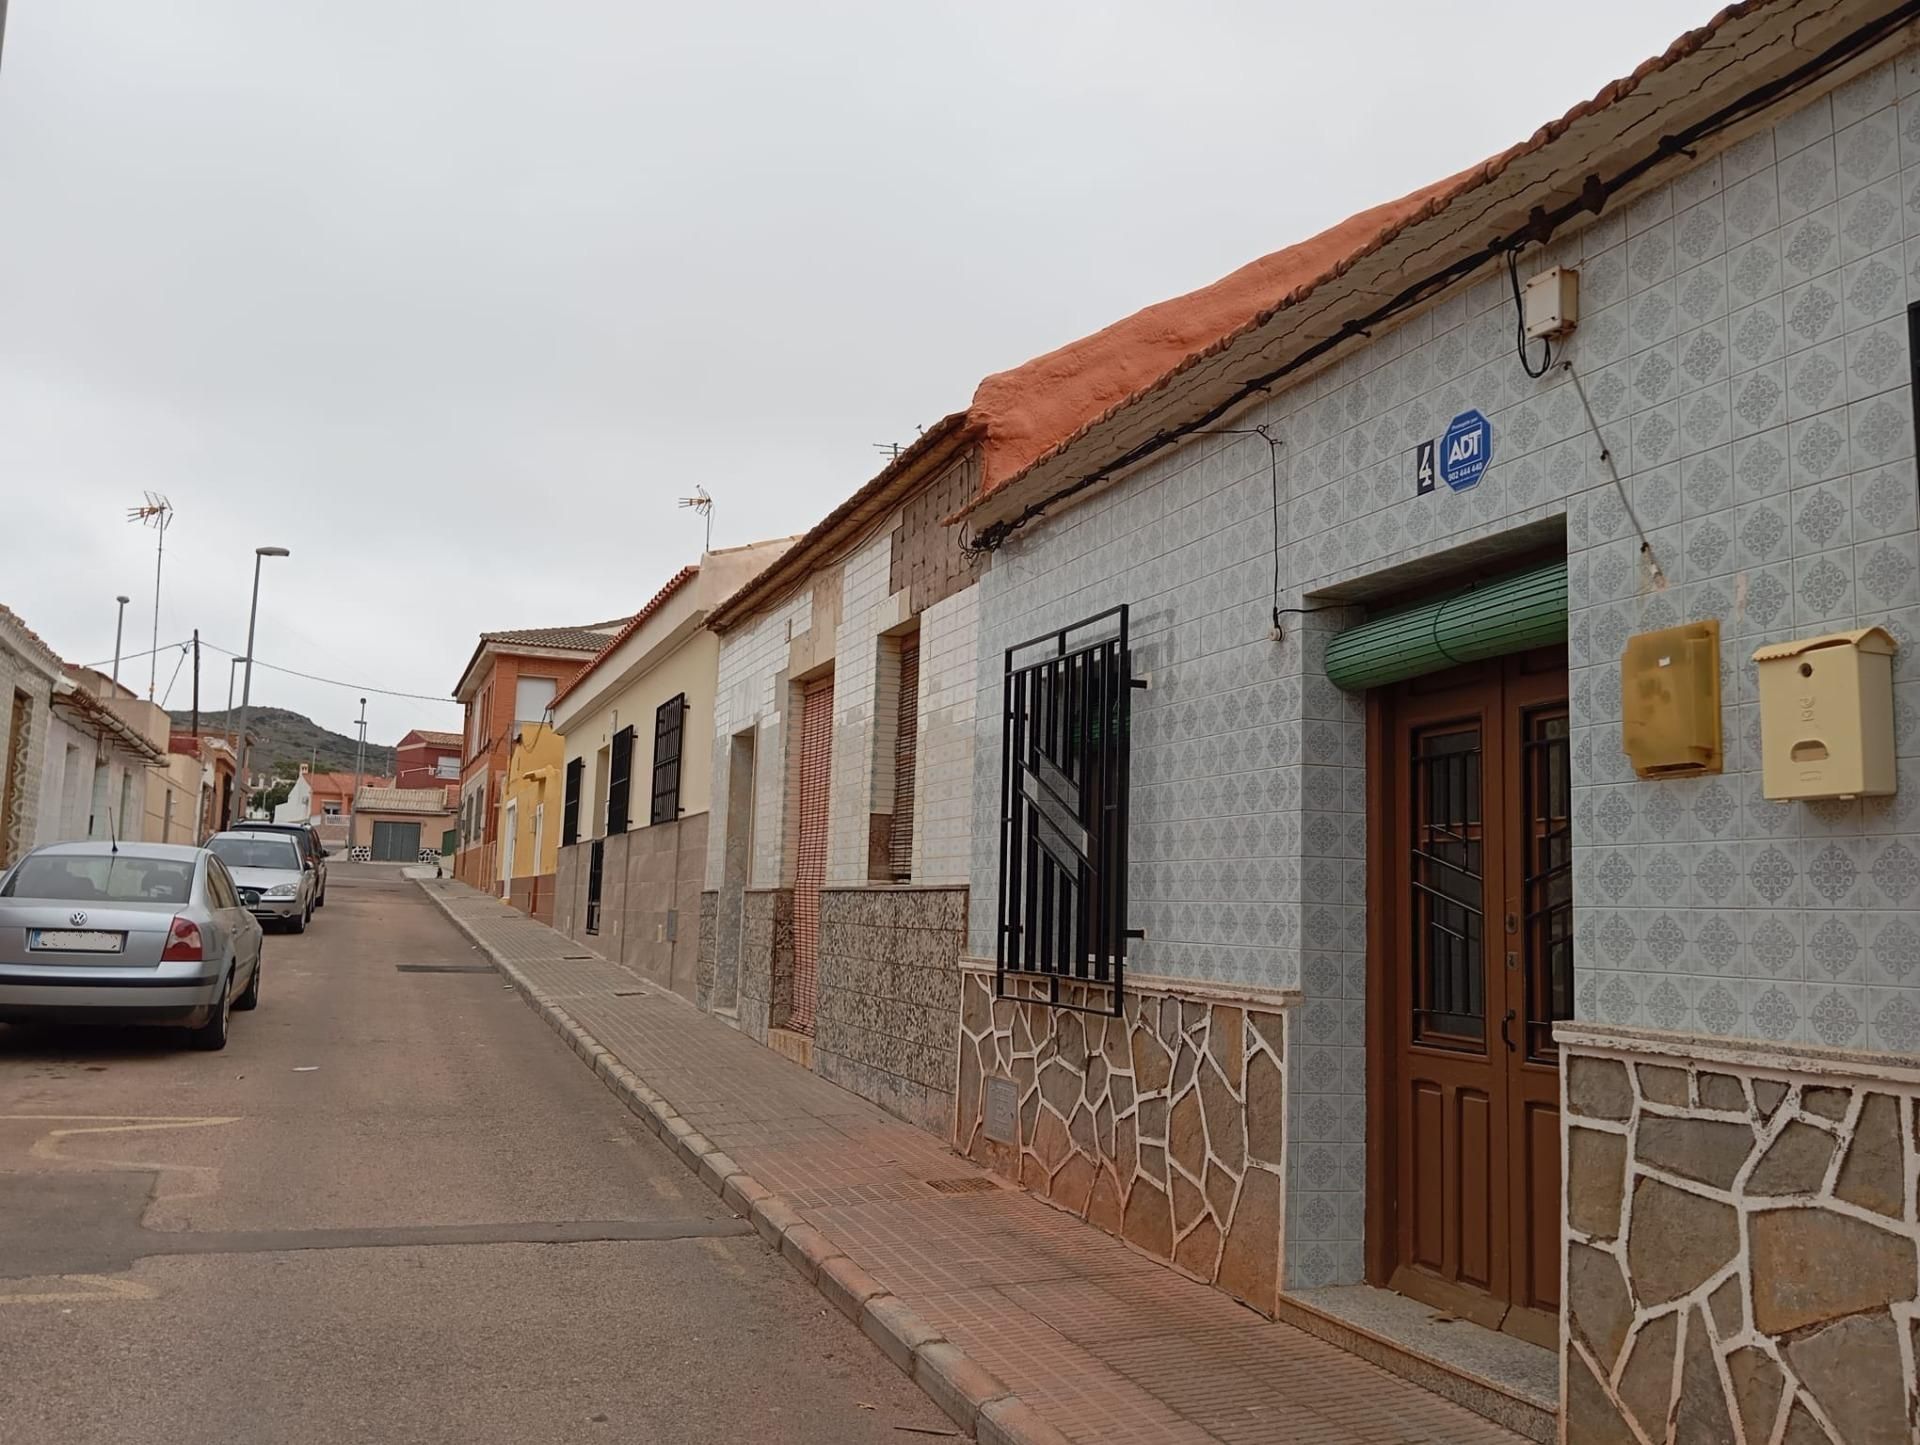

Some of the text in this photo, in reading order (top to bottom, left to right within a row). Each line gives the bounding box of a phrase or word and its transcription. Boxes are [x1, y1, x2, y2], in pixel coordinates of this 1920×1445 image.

[1448, 429, 1482, 465] ADT
[1419, 445, 1432, 487] 4
[1447, 471, 1459, 481] 902
[1460, 466, 1471, 477] 444
